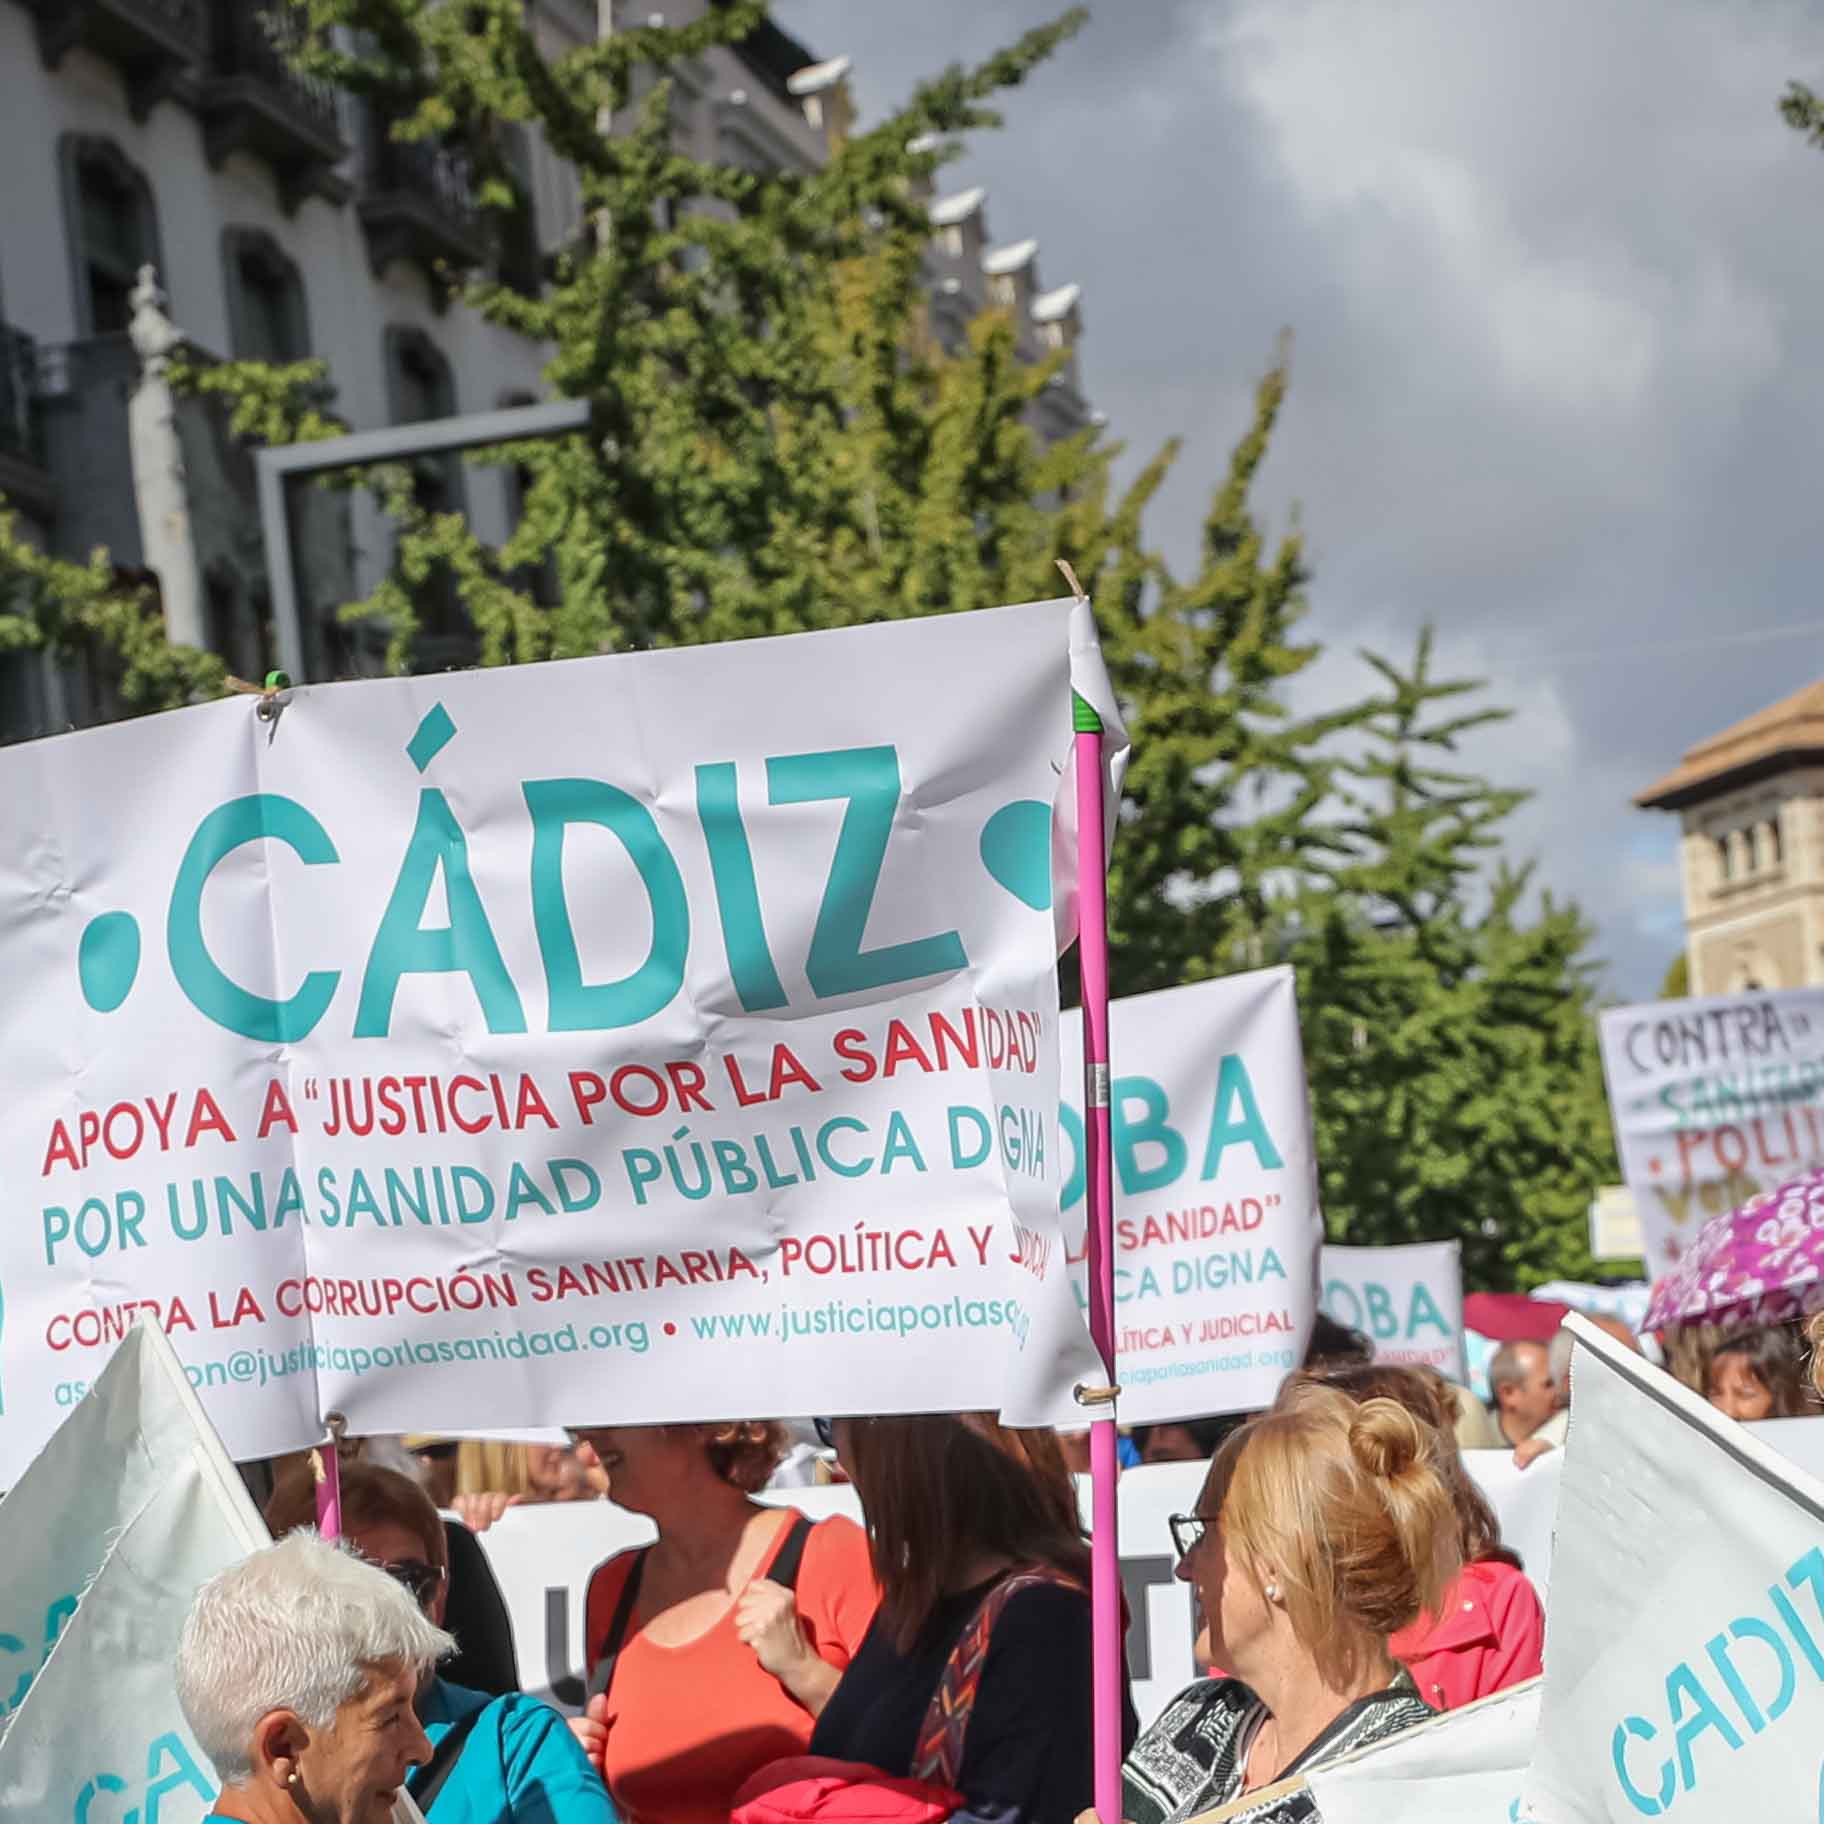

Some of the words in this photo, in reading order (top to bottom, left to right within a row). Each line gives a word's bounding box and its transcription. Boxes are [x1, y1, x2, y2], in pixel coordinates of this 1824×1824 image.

[167, 701, 968, 1043] CÁDIZ
[1626, 1001, 1791, 1074] CONTRA
[42, 1088, 235, 1176] APOYA
[257, 1077, 298, 1138] A
[574, 1060, 711, 1130] POR
[727, 1043, 822, 1108] LA
[43, 1190, 148, 1265] POR
[166, 1170, 311, 1243] UNA
[318, 1157, 603, 1230] SANIDAD
[626, 1109, 928, 1206] PÚBLICA
[208, 1287, 266, 1329] LA
[276, 1267, 518, 1318] CORRUPCIÓN
[528, 1245, 769, 1303] SANITARIA,
[780, 1221, 957, 1276] POLÍTICA
[968, 1225, 994, 1265] Y
[1172, 1247, 1287, 1297] DIGNA
[1180, 1315, 1194, 1342] Y
[1198, 1309, 1296, 1344] JUDICIAL
